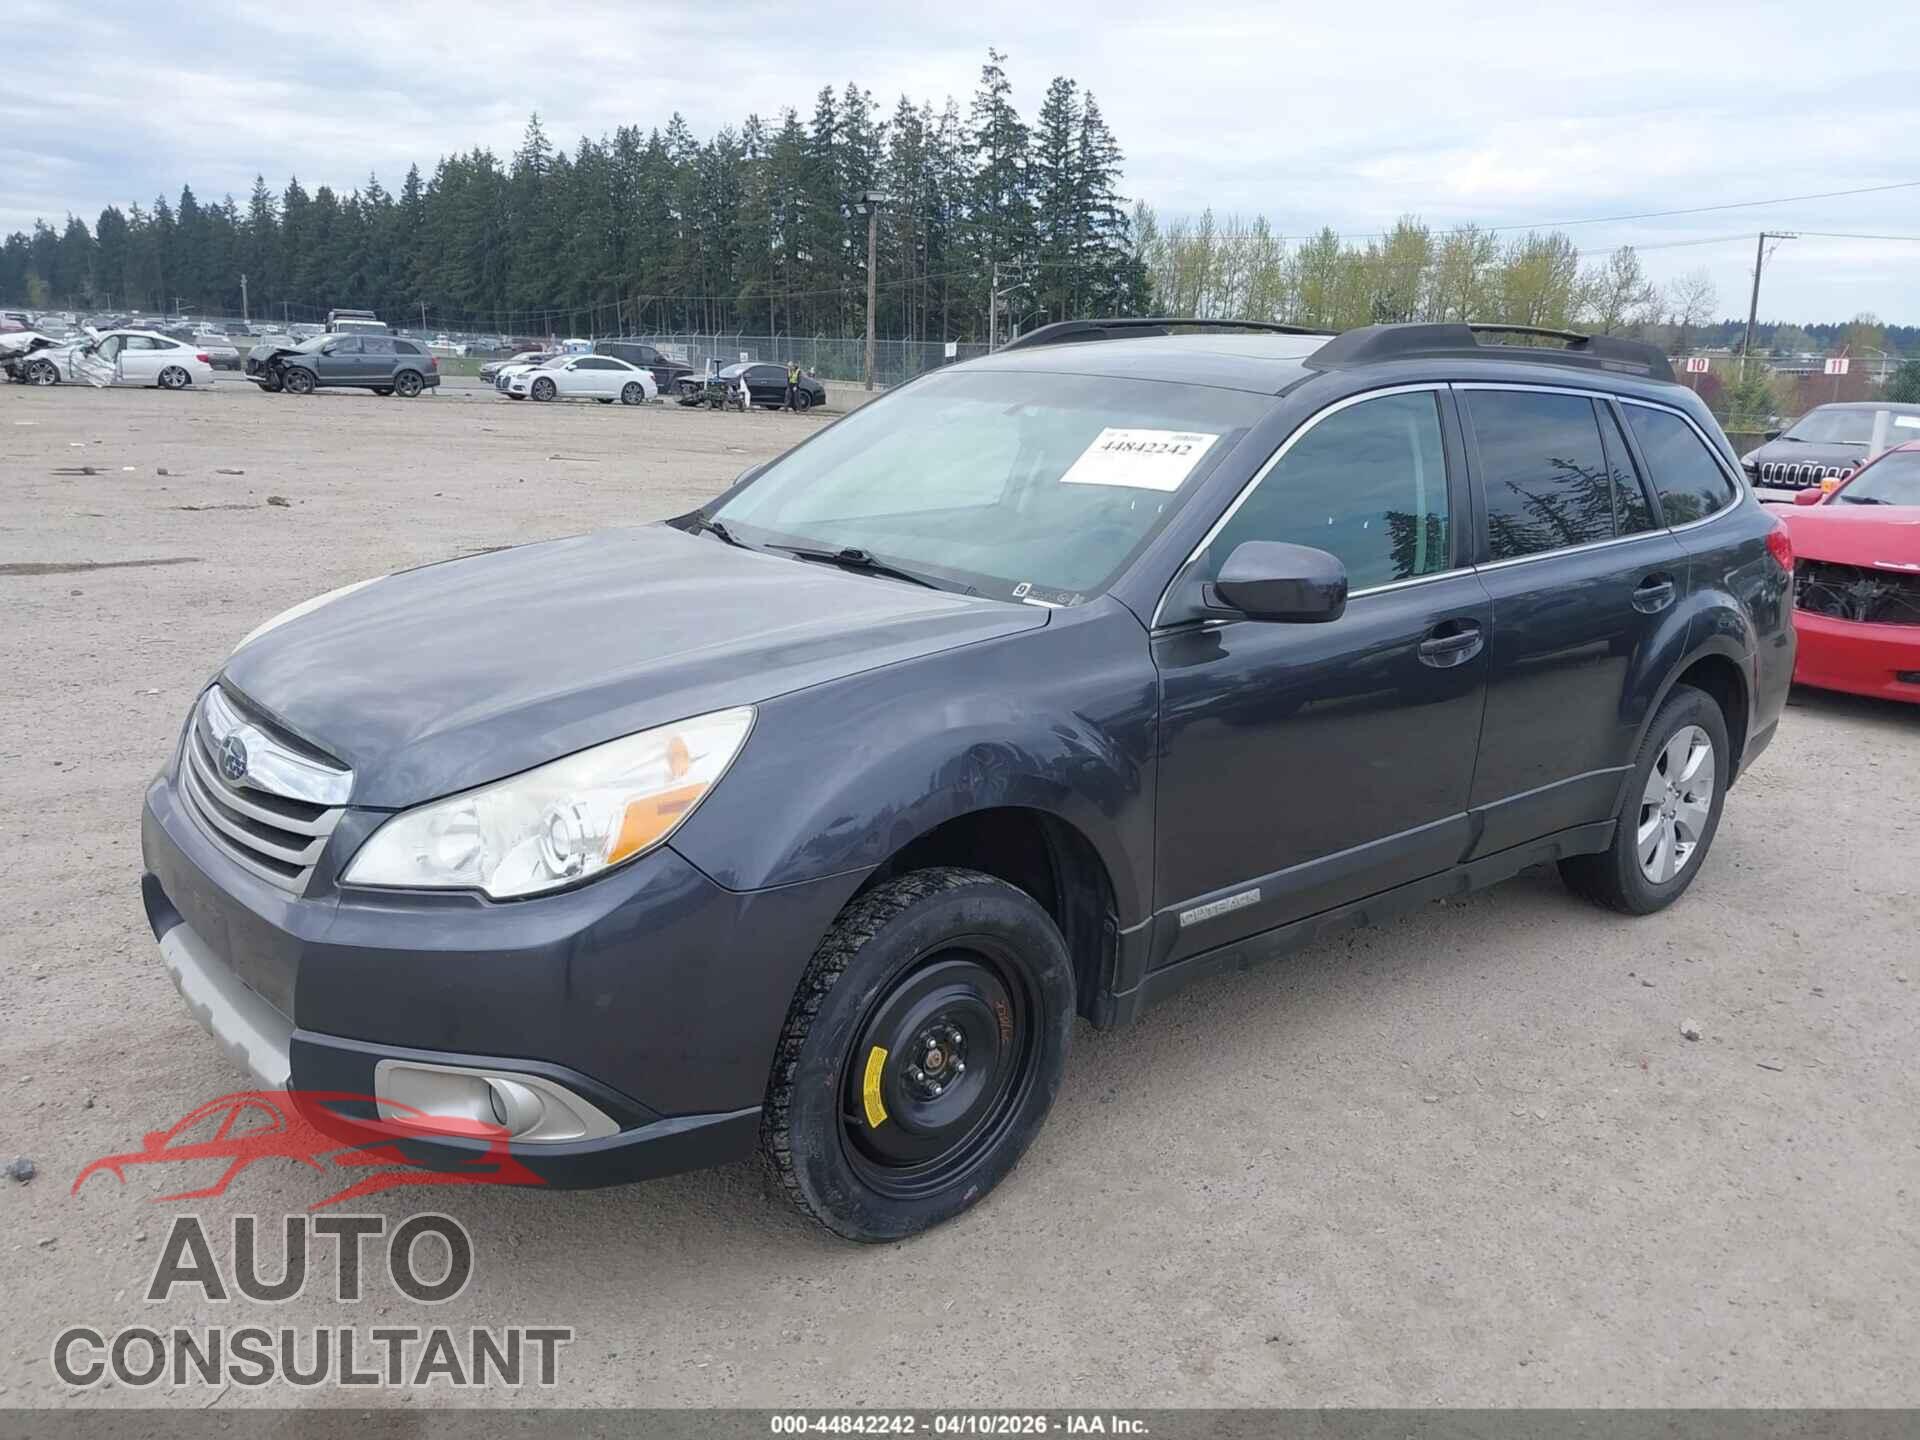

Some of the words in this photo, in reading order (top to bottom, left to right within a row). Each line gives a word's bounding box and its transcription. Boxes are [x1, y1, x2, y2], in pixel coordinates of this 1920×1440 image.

[1691, 358, 1705, 371] 10
[1831, 359, 1843, 373] 11
[1101, 440, 1193, 456] 44842242
